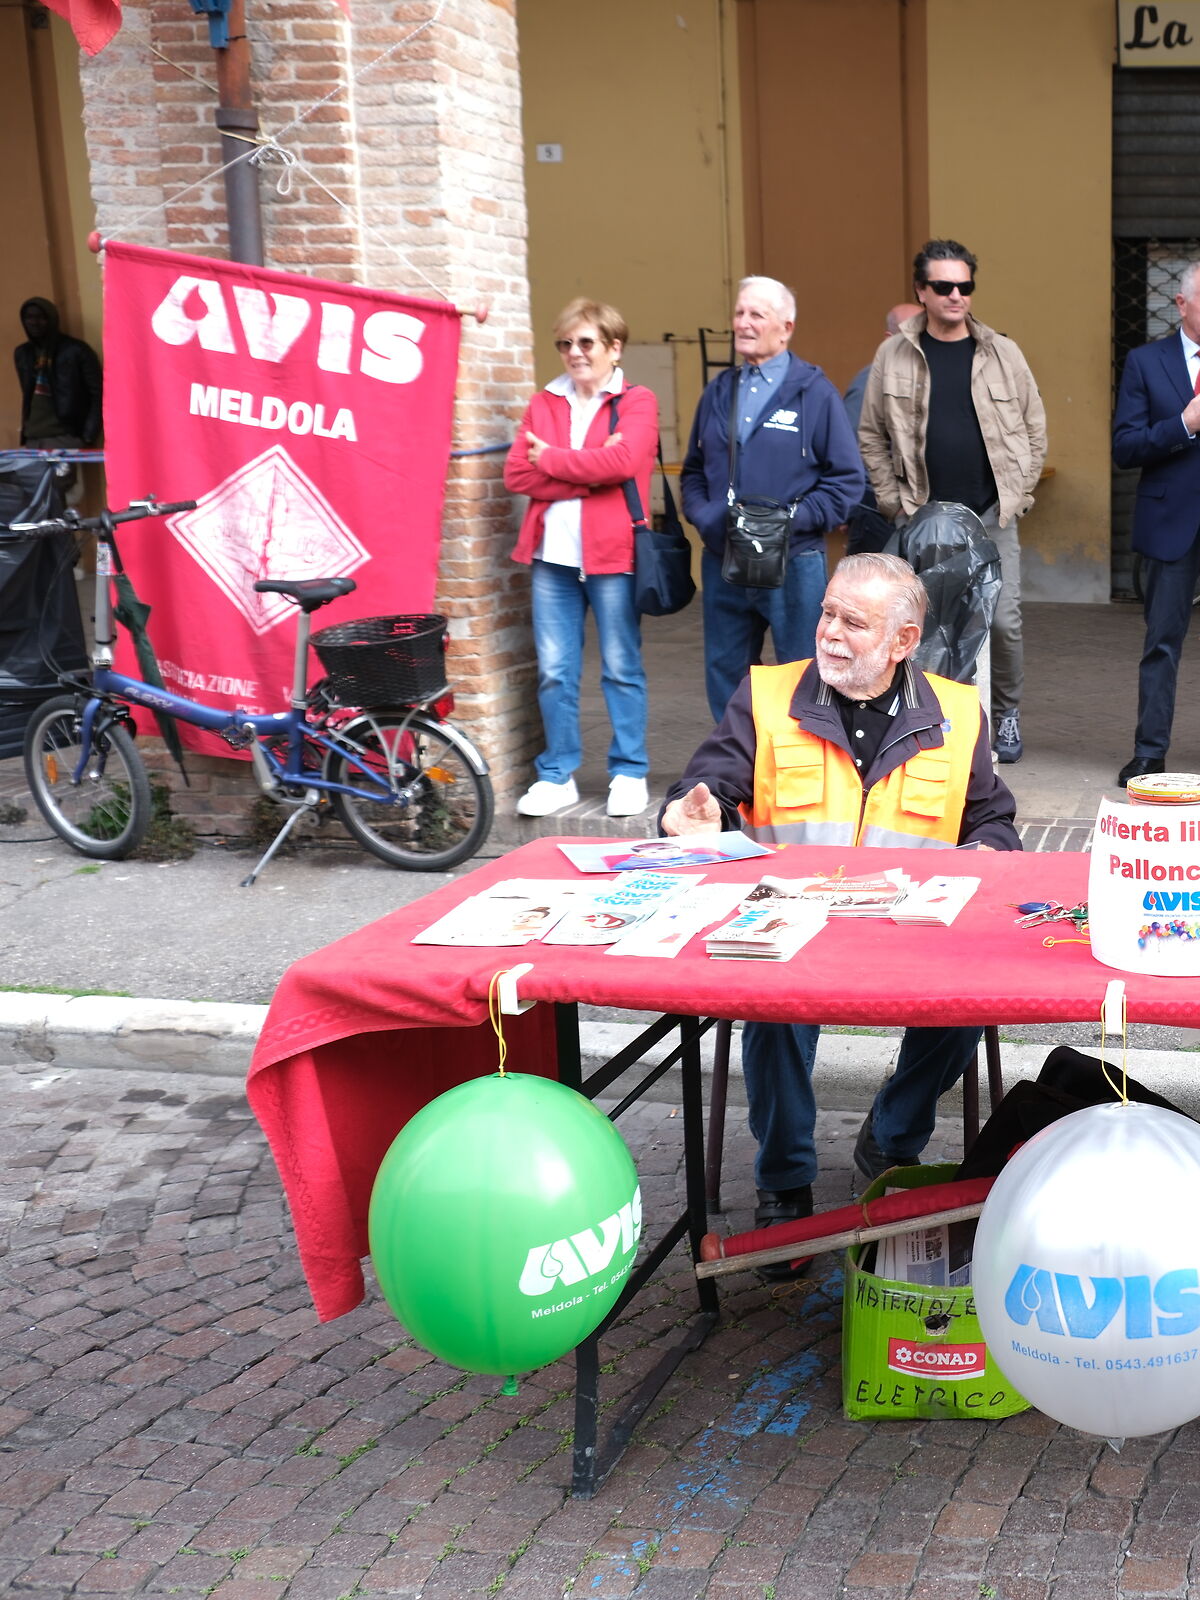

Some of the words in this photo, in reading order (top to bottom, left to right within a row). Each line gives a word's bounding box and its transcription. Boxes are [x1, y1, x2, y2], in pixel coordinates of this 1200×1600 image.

[1124, 5, 1193, 49] La
[152, 275, 426, 384] AVIS
[190, 383, 358, 441] MELDOLA
[1101, 815, 1169, 842] offerta
[531, 1296, 583, 1319] Meldola
[913, 1352, 977, 1365] CONAD
[1012, 1340, 1060, 1365] Meldola
[1074, 1357, 1100, 1370] Tel.
[1105, 1349, 1198, 1370] 0543.491637
[857, 1380, 1005, 1408] ELETRICO
